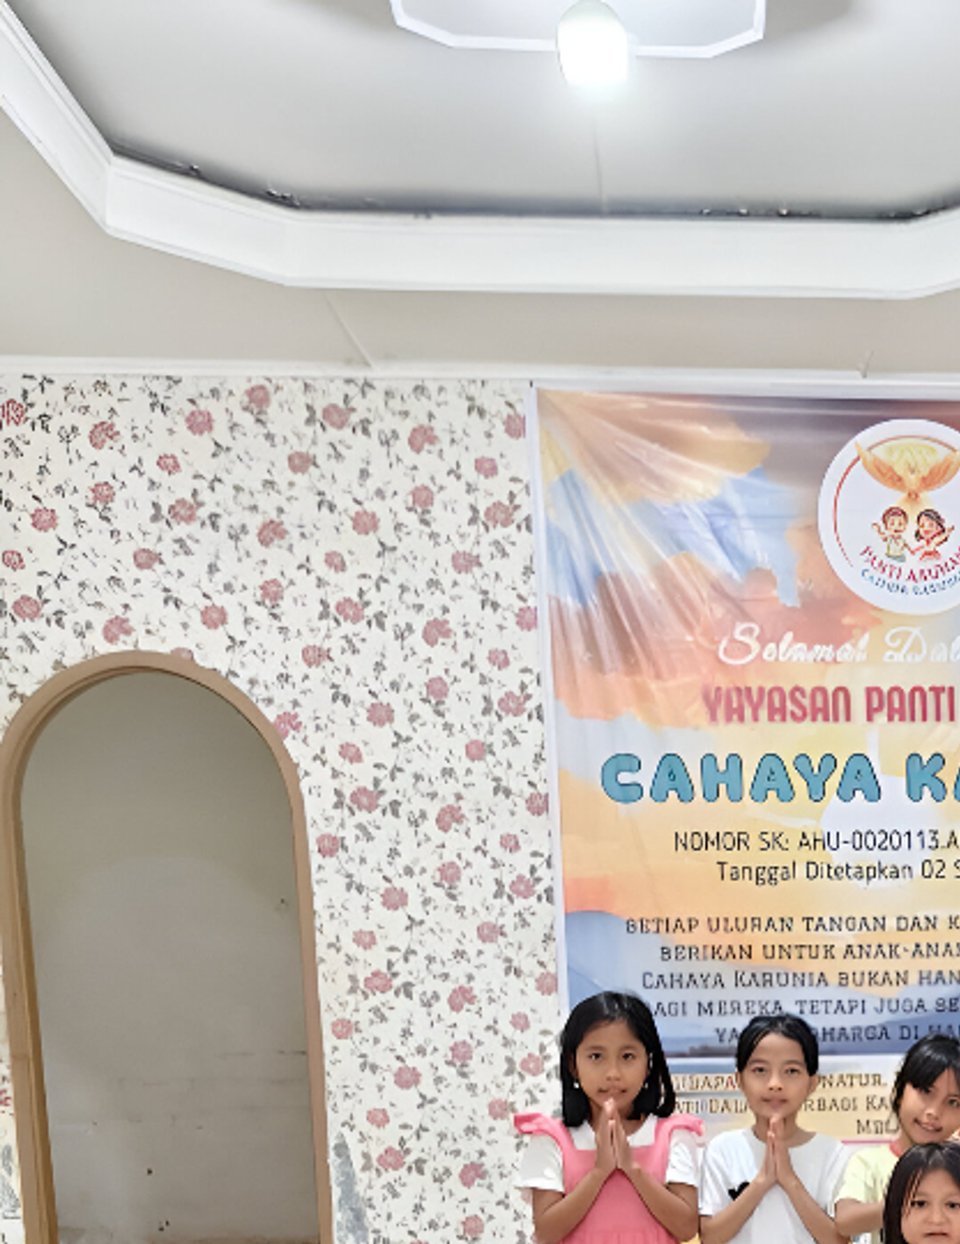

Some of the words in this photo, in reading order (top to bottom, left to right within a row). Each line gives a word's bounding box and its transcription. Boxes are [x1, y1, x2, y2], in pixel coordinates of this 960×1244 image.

[704, 685, 852, 723] YAYASAN
[865, 685, 956, 723] PANTI
[600, 752, 882, 804] CAHAYA
[673, 832, 751, 852] NOMOR
[758, 831, 790, 851] SK:
[716, 861, 796, 887] Tanggal
[806, 860, 914, 886] Ditetapkan
[921, 860, 946, 880] 02
[707, 916, 794, 934] ULURAN
[802, 915, 887, 933] TANGAN
[896, 915, 938, 932] DAN
[660, 944, 752, 962] BERIKAN
[762, 943, 836, 960] UNTUK
[642, 972, 725, 989] CAHAYA
[735, 971, 833, 988] KARUNIA
[838, 970, 909, 988] BUKAN
[651, 1000, 688, 1017] AGI
[795, 999, 867, 1016] TETAPI
[874, 997, 928, 1014] JUGA
[900, 1026, 919, 1041] DI
